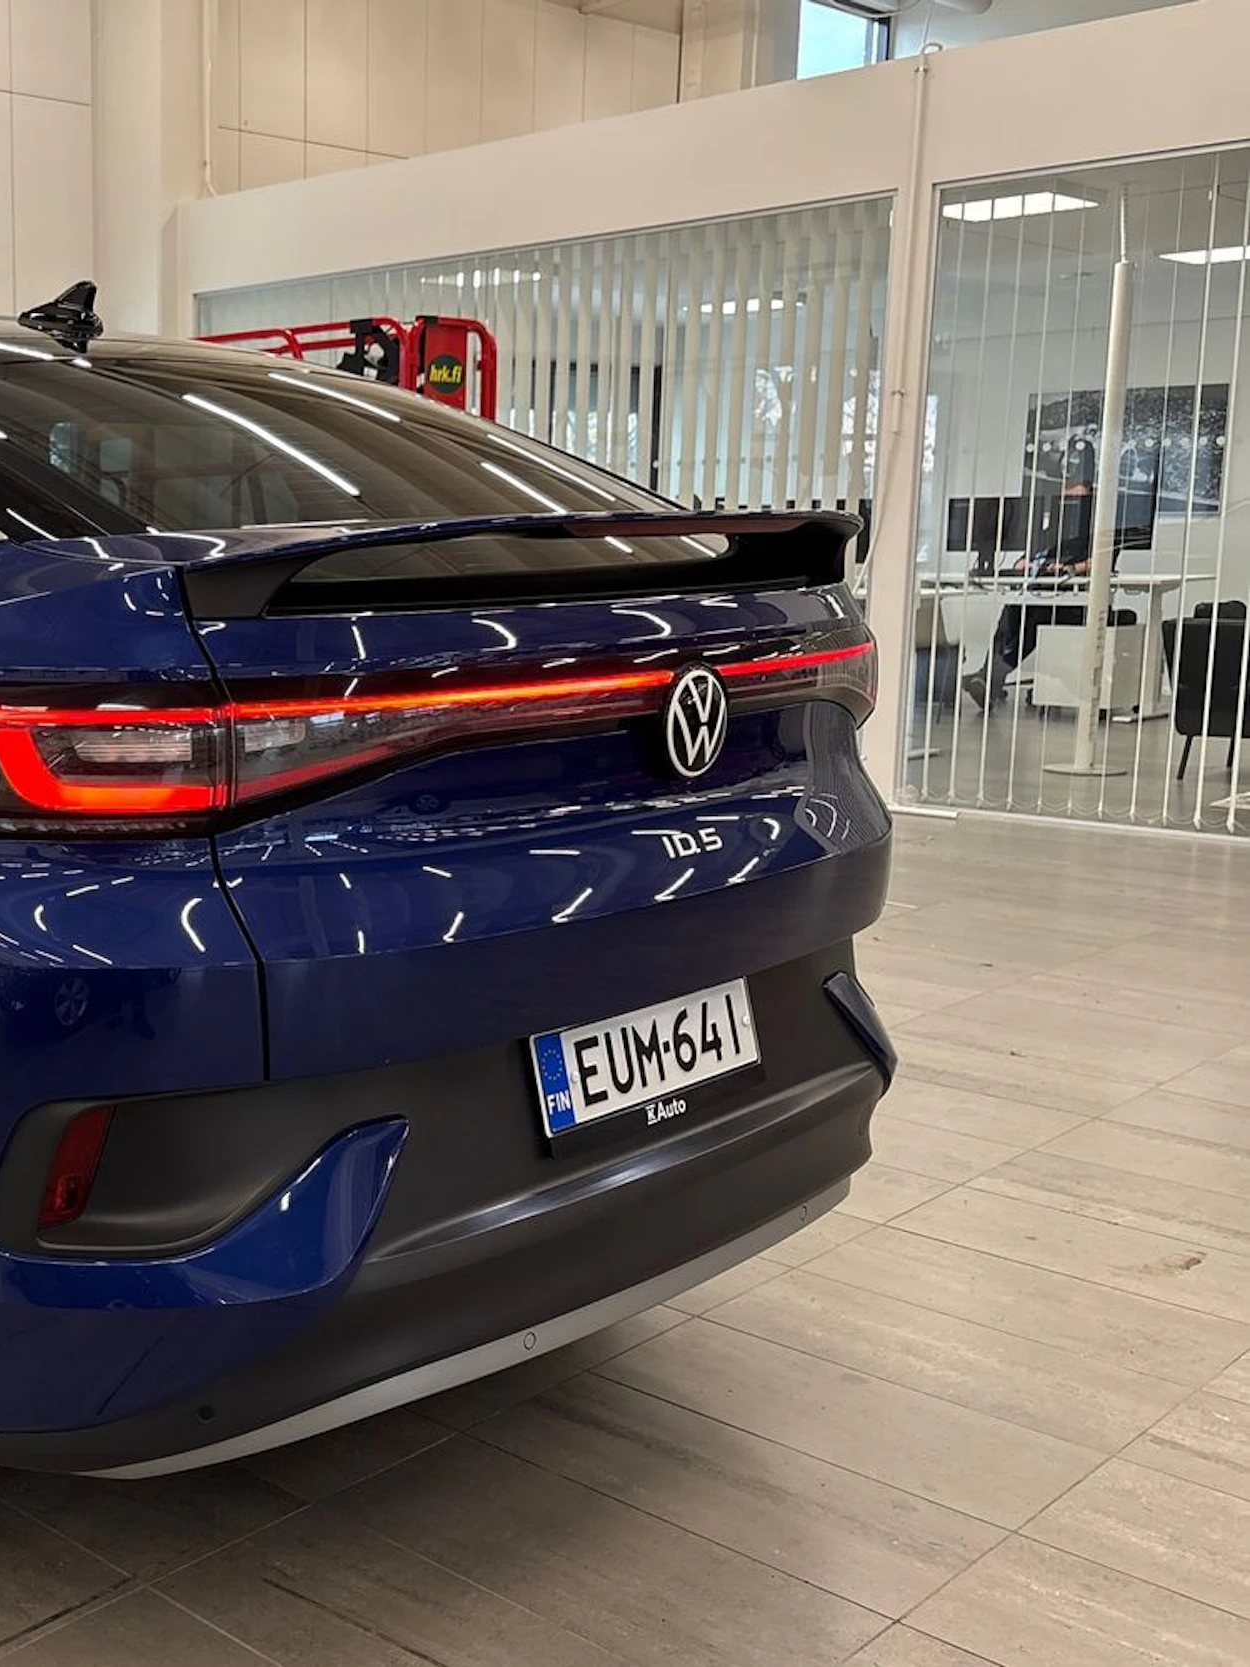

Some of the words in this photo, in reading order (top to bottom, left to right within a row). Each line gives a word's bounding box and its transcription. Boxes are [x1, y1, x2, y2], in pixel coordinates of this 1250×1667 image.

[429, 364, 463, 384] hrk.fi
[661, 827, 723, 859] ID.5
[573, 994, 741, 1107] EUM-641
[547, 1090, 571, 1115] FIN
